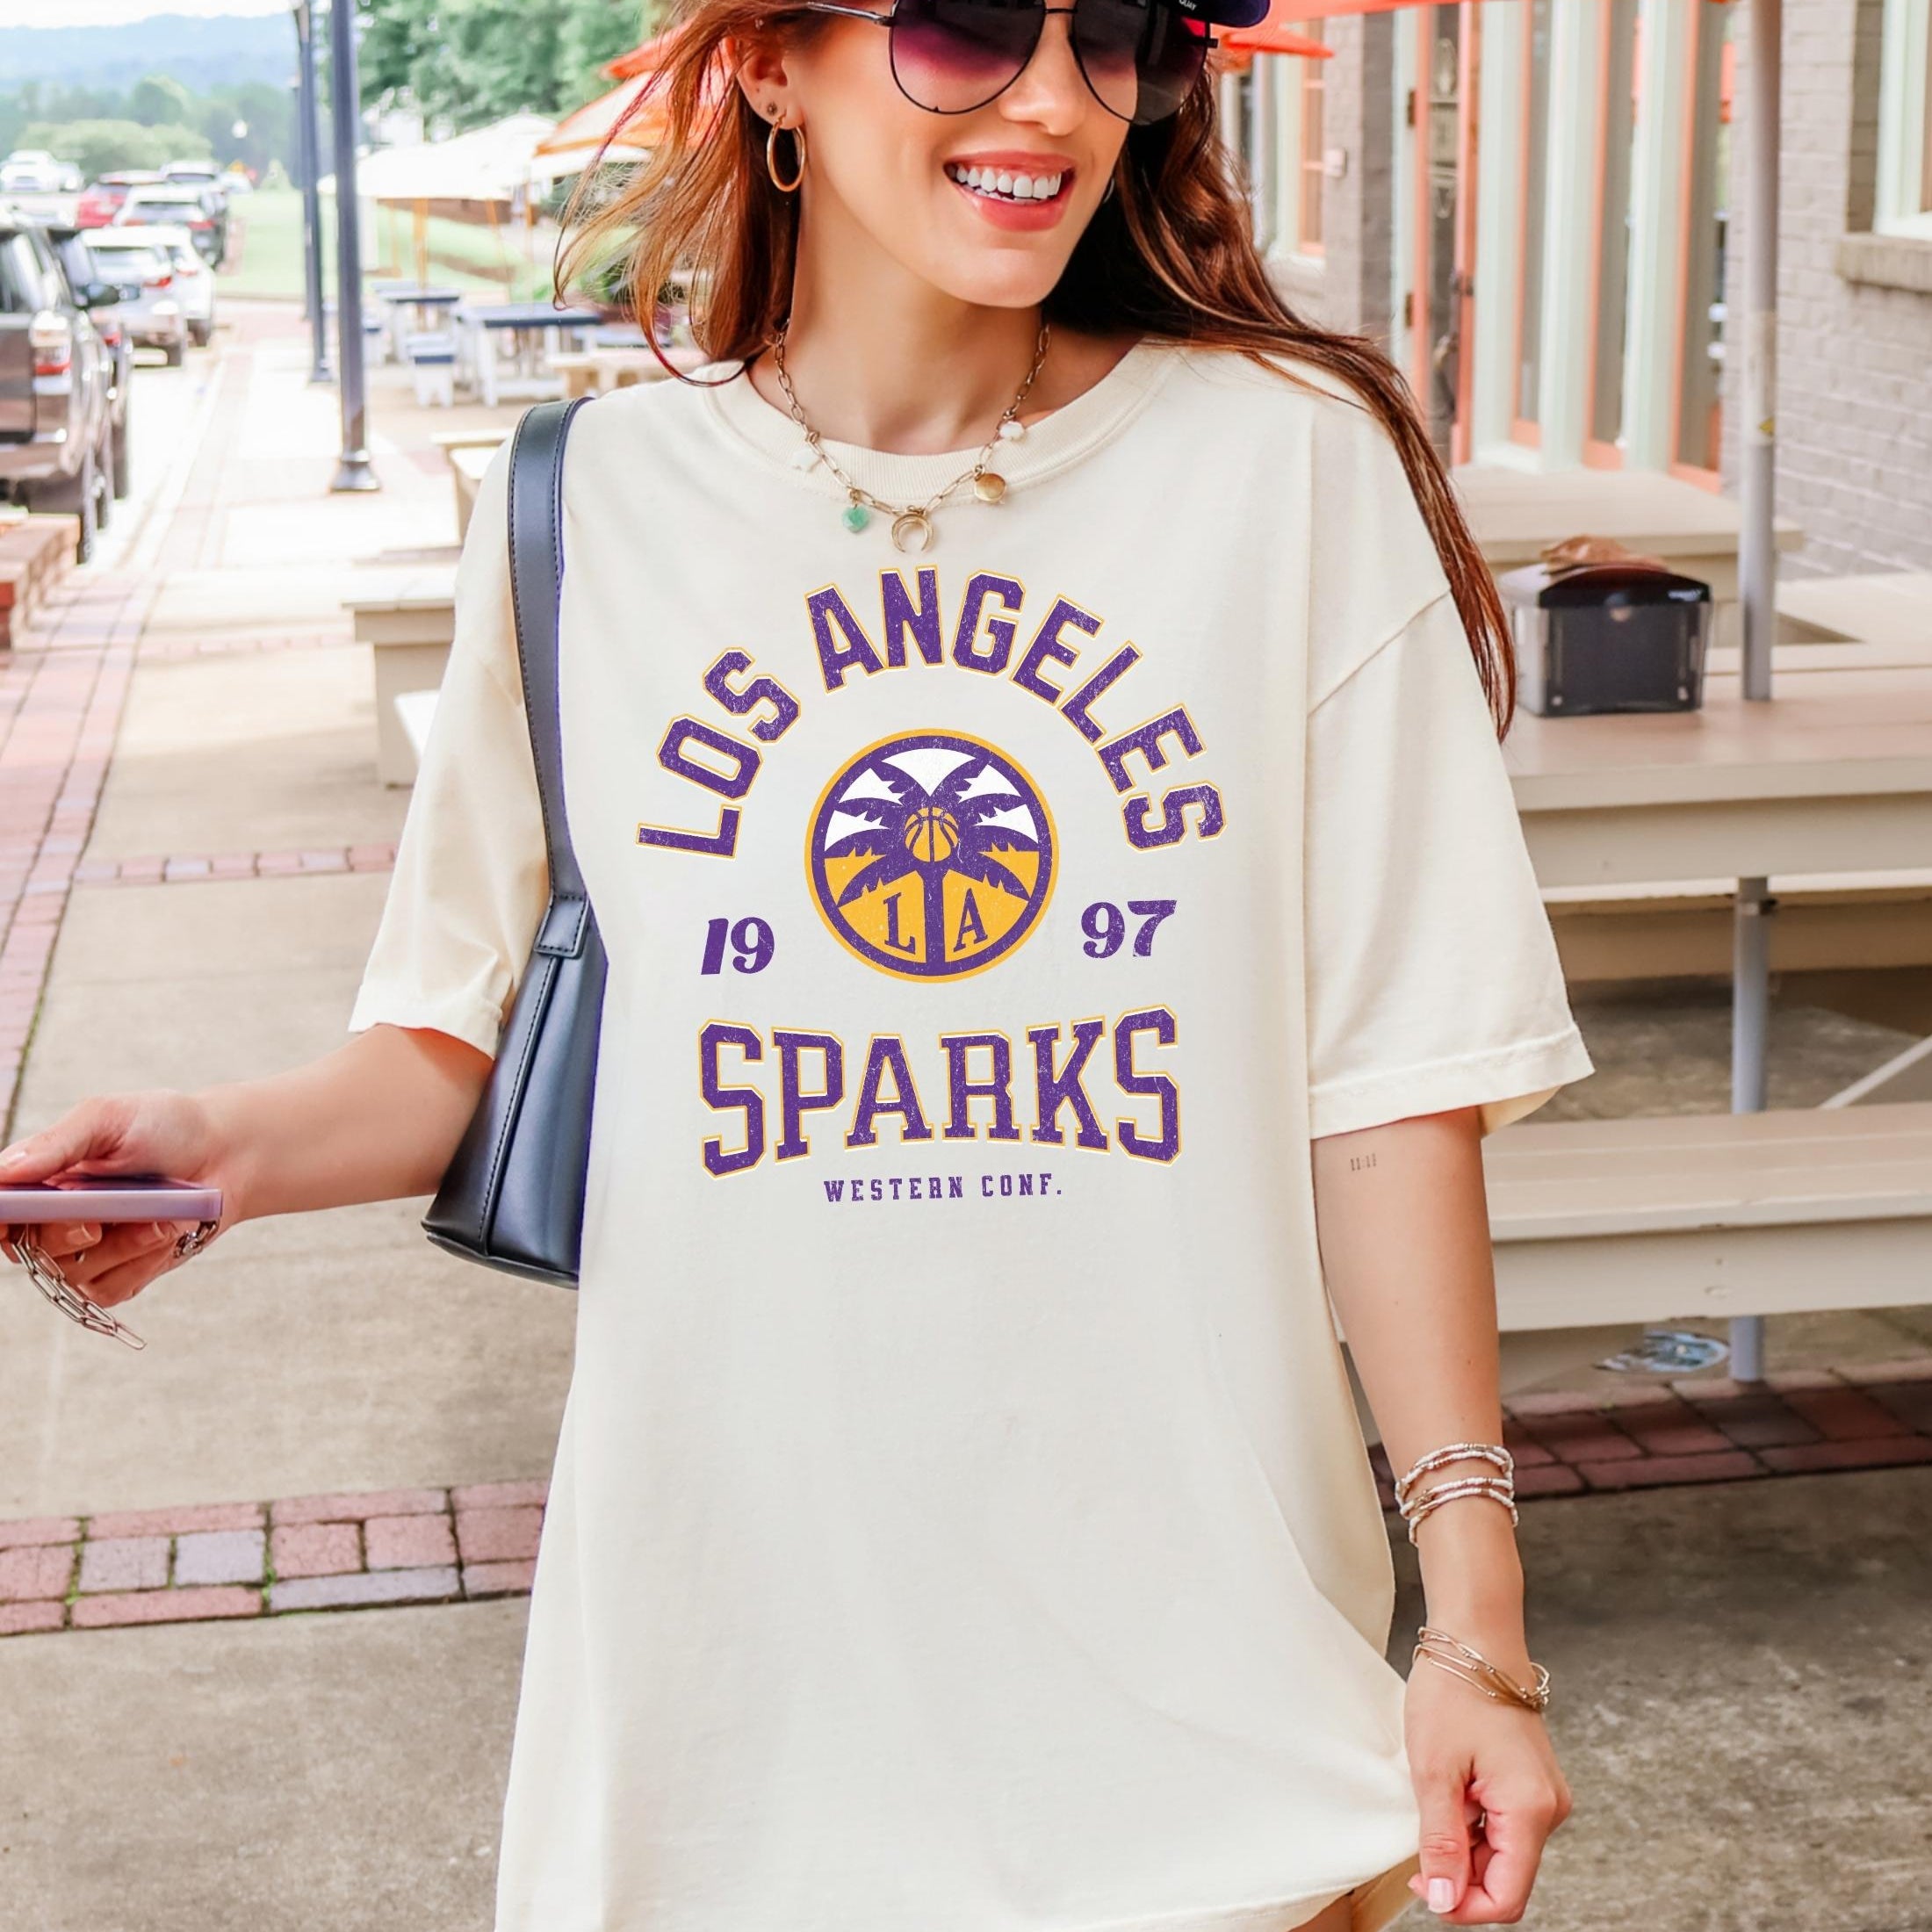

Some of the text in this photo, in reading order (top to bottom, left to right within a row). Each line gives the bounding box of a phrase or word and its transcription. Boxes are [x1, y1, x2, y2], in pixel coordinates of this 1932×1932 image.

[636, 564, 1227, 859] LOS ANGELES
[701, 900, 1177, 975] 19 97
[698, 1004, 1183, 1179] SPARKS
[824, 1173, 1061, 1202] WESTERN CONF.
